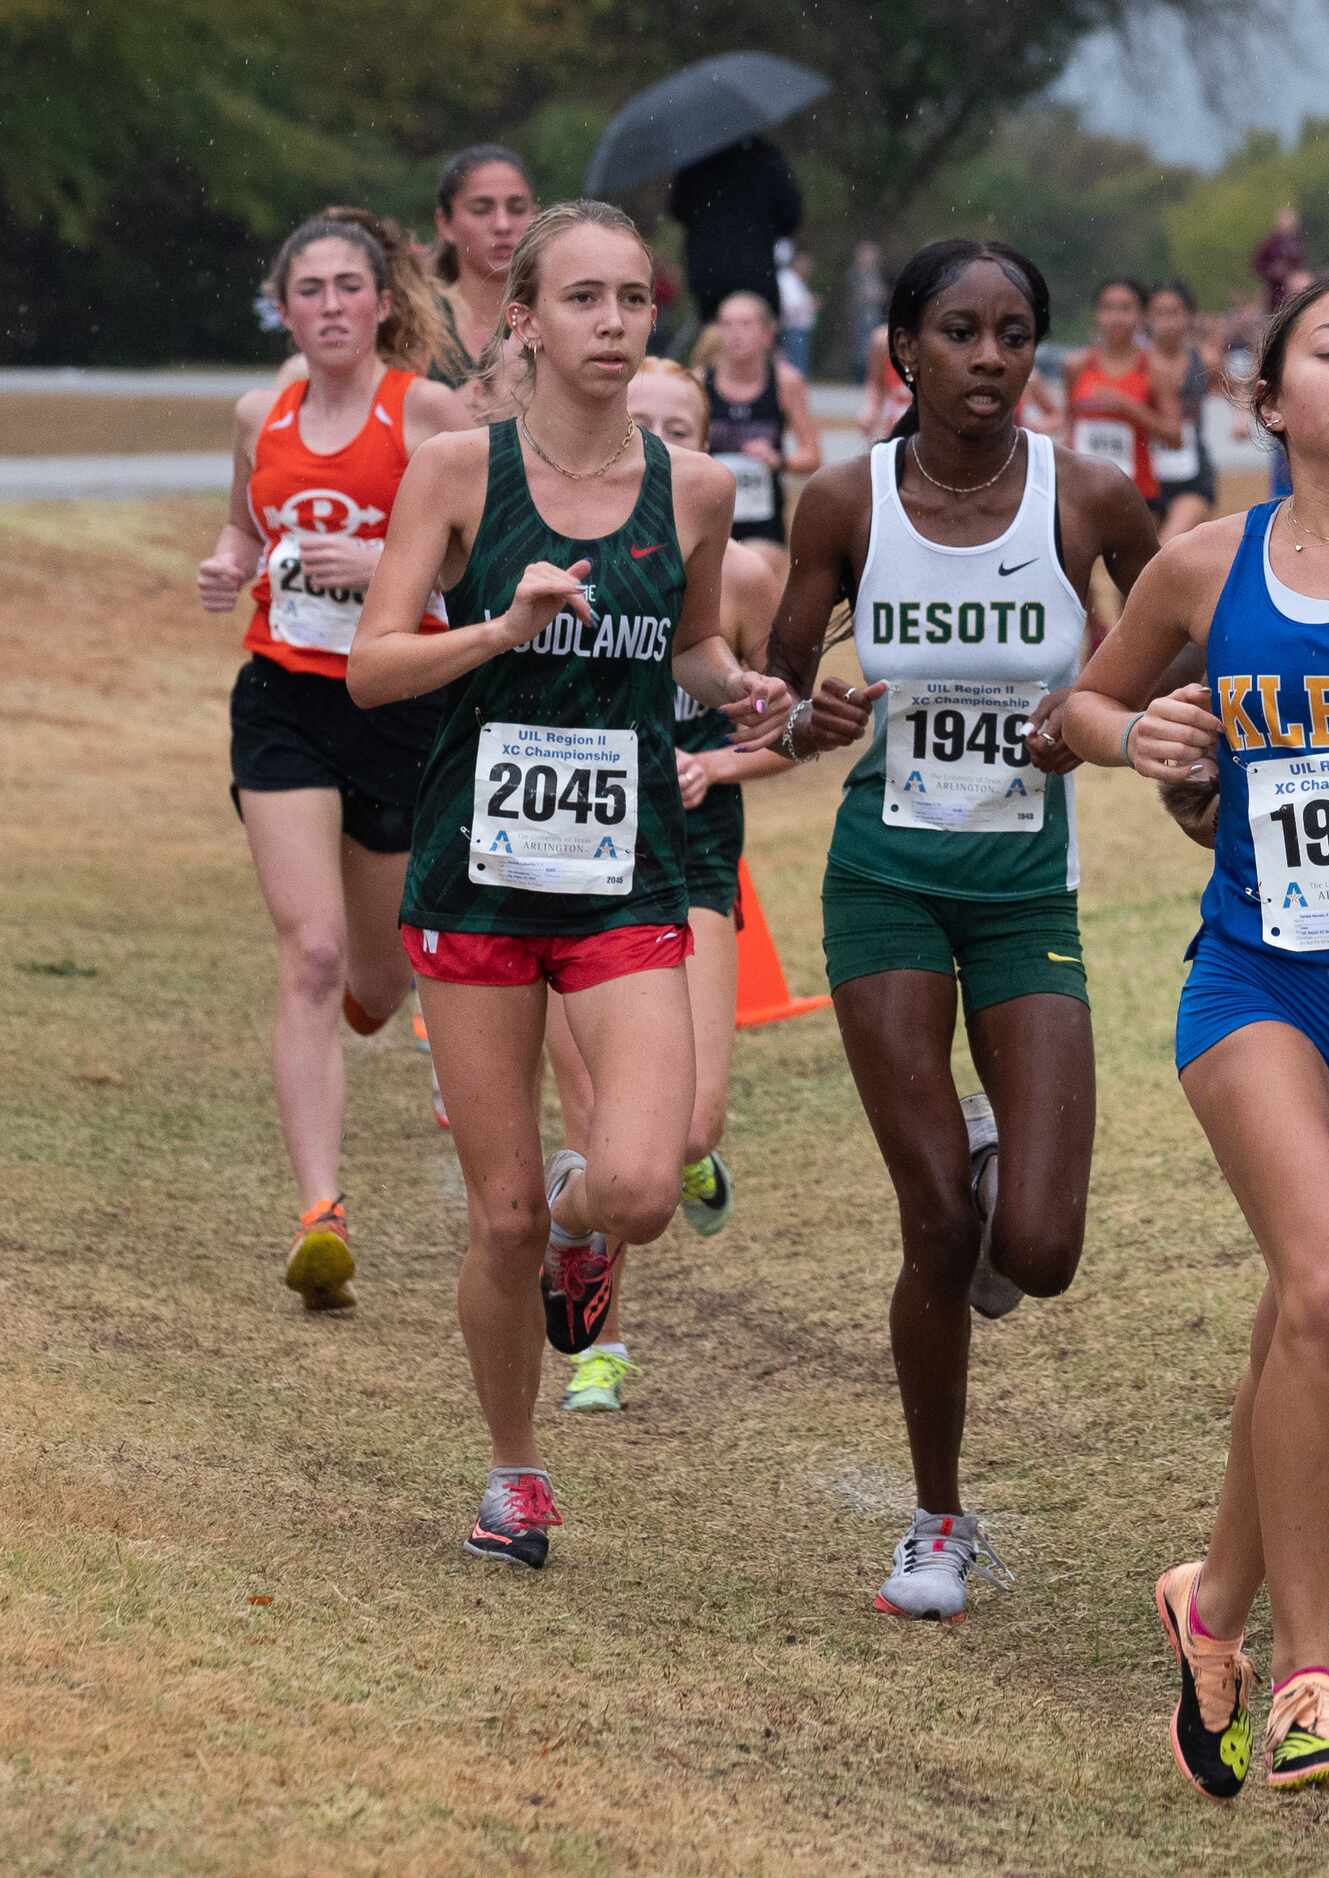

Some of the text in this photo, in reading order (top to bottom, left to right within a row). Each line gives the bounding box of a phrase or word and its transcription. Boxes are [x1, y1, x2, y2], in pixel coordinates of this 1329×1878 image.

[873, 601, 1045, 645] DESOTO
[927, 684, 950, 693] UIL
[955, 684, 1001, 695] Region
[911, 696, 1030, 708] XC Championship
[518, 730, 542, 741] UIL
[546, 732, 593, 746] Region
[905, 709, 1032, 768] 1949
[502, 744, 620, 763] XC Championship
[1289, 763, 1316, 776] UIL
[487, 762, 628, 826] 2045
[935, 782, 994, 793] ARLINGTON
[1275, 782, 1296, 795] XC
[523, 842, 584, 853] ARLINGTON
